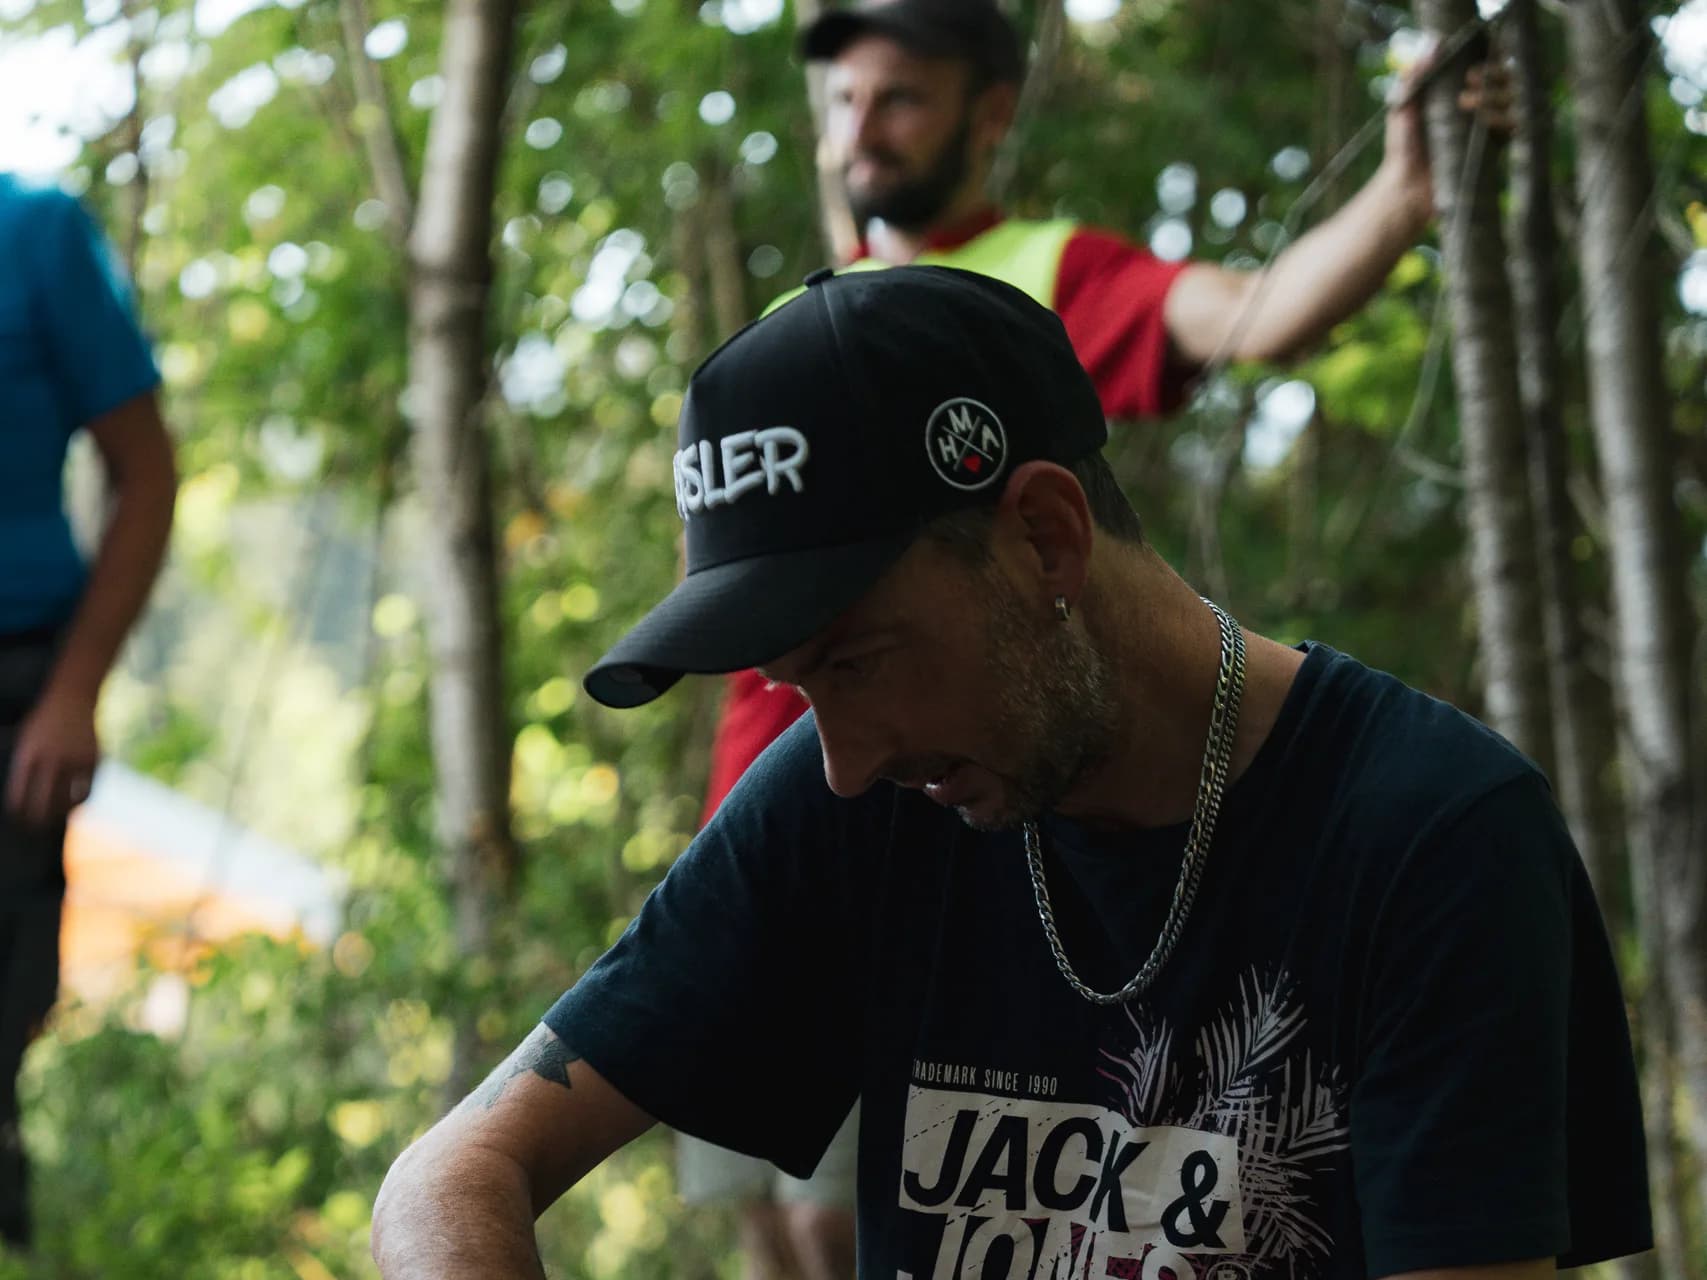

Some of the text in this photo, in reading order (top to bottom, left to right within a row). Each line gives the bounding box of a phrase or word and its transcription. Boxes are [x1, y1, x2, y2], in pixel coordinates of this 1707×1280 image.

[672, 425, 810, 521] SLER
[984, 1068, 1019, 1092] SINCE
[1027, 1075, 1058, 1096] 1990
[903, 1108, 1231, 1250] JACK &
